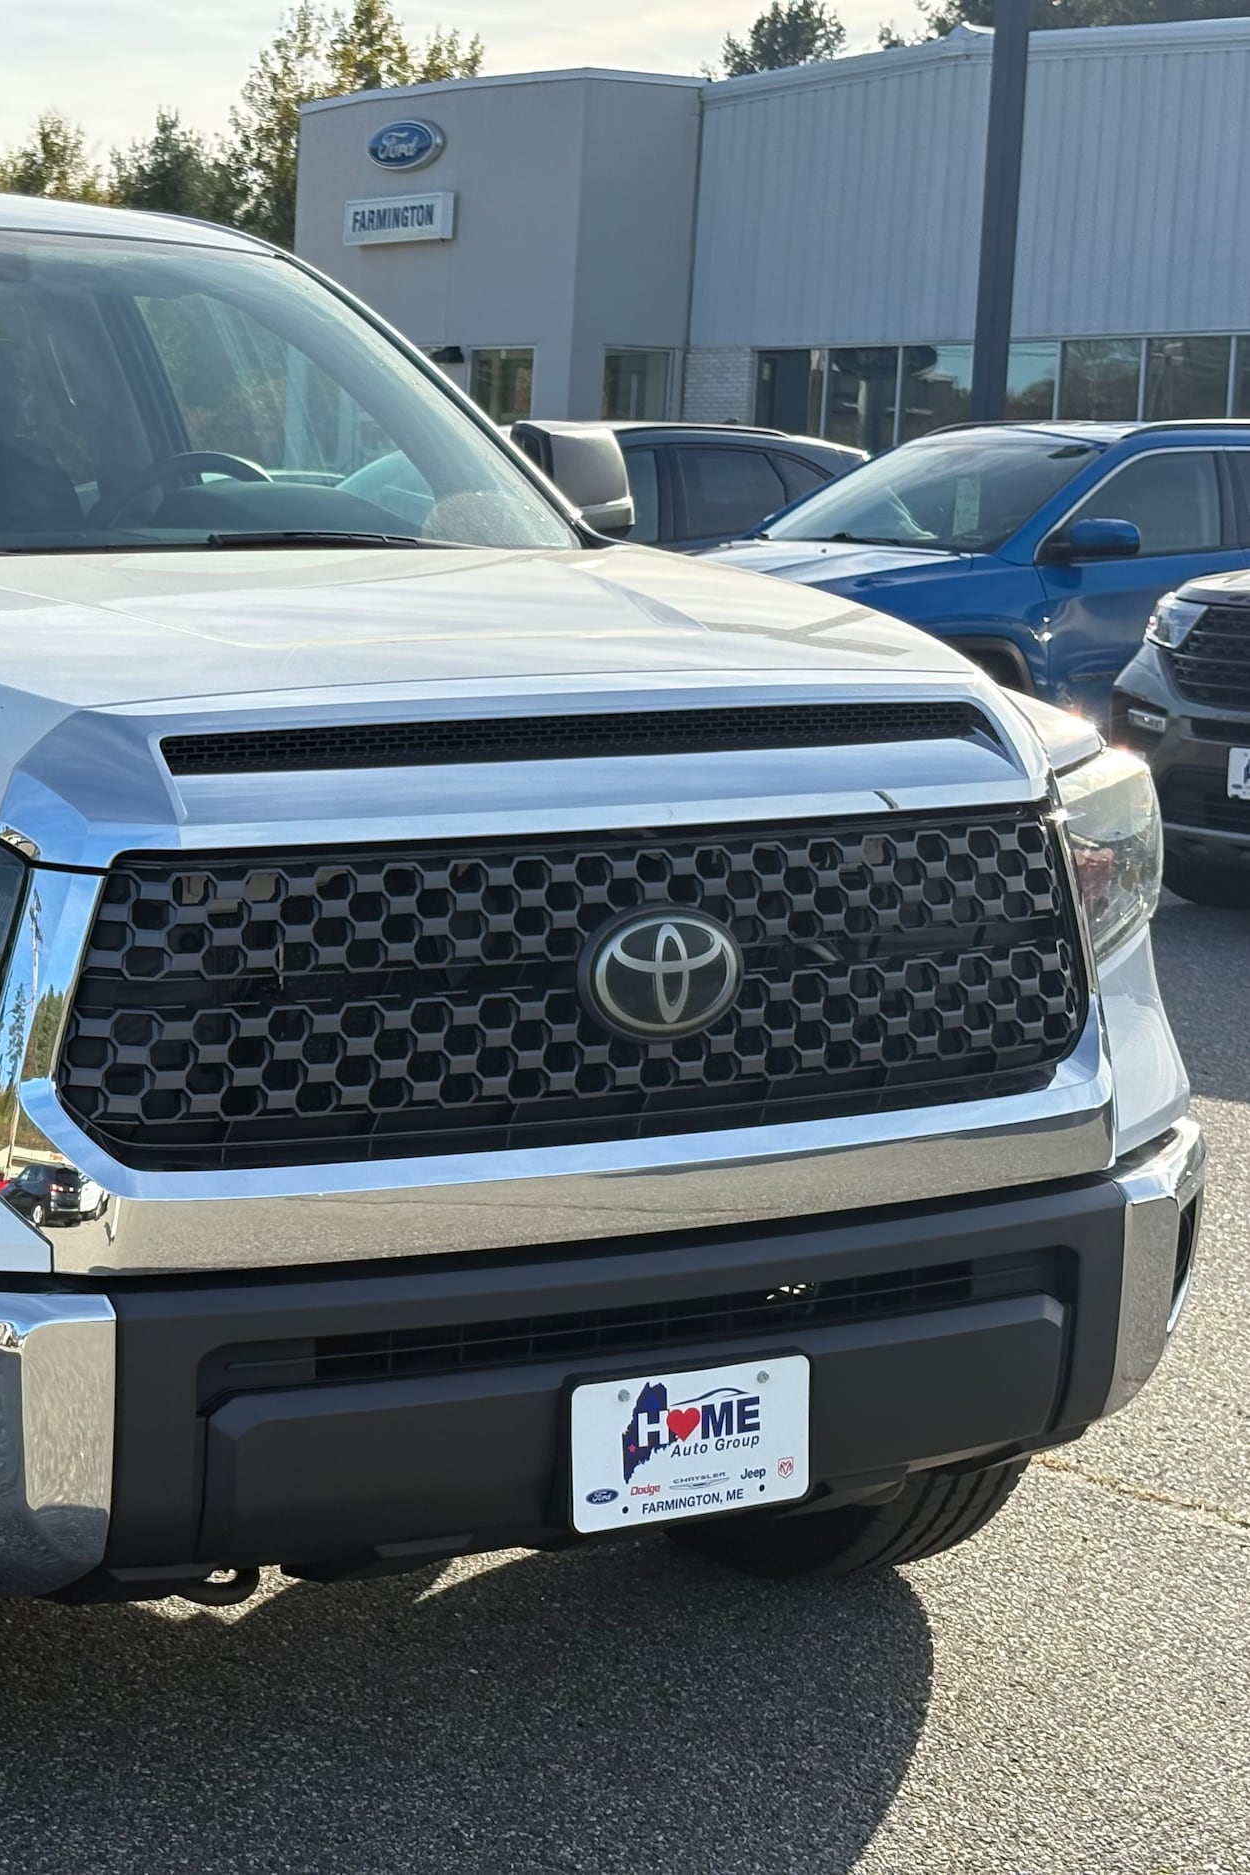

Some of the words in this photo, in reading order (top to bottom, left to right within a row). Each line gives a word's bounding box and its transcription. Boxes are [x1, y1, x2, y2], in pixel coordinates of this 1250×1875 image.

[377, 130, 420, 160] Ford
[351, 203, 435, 233] FARMINGTON
[670, 1441, 708, 1458] Auto
[715, 1434, 760, 1452] Group
[672, 1471, 726, 1485] CHRYSLER
[740, 1466, 767, 1481] Jeep
[630, 1483, 661, 1496] Dodge
[641, 1491, 724, 1516] FARMINGTON,
[726, 1488, 745, 1502] ME
